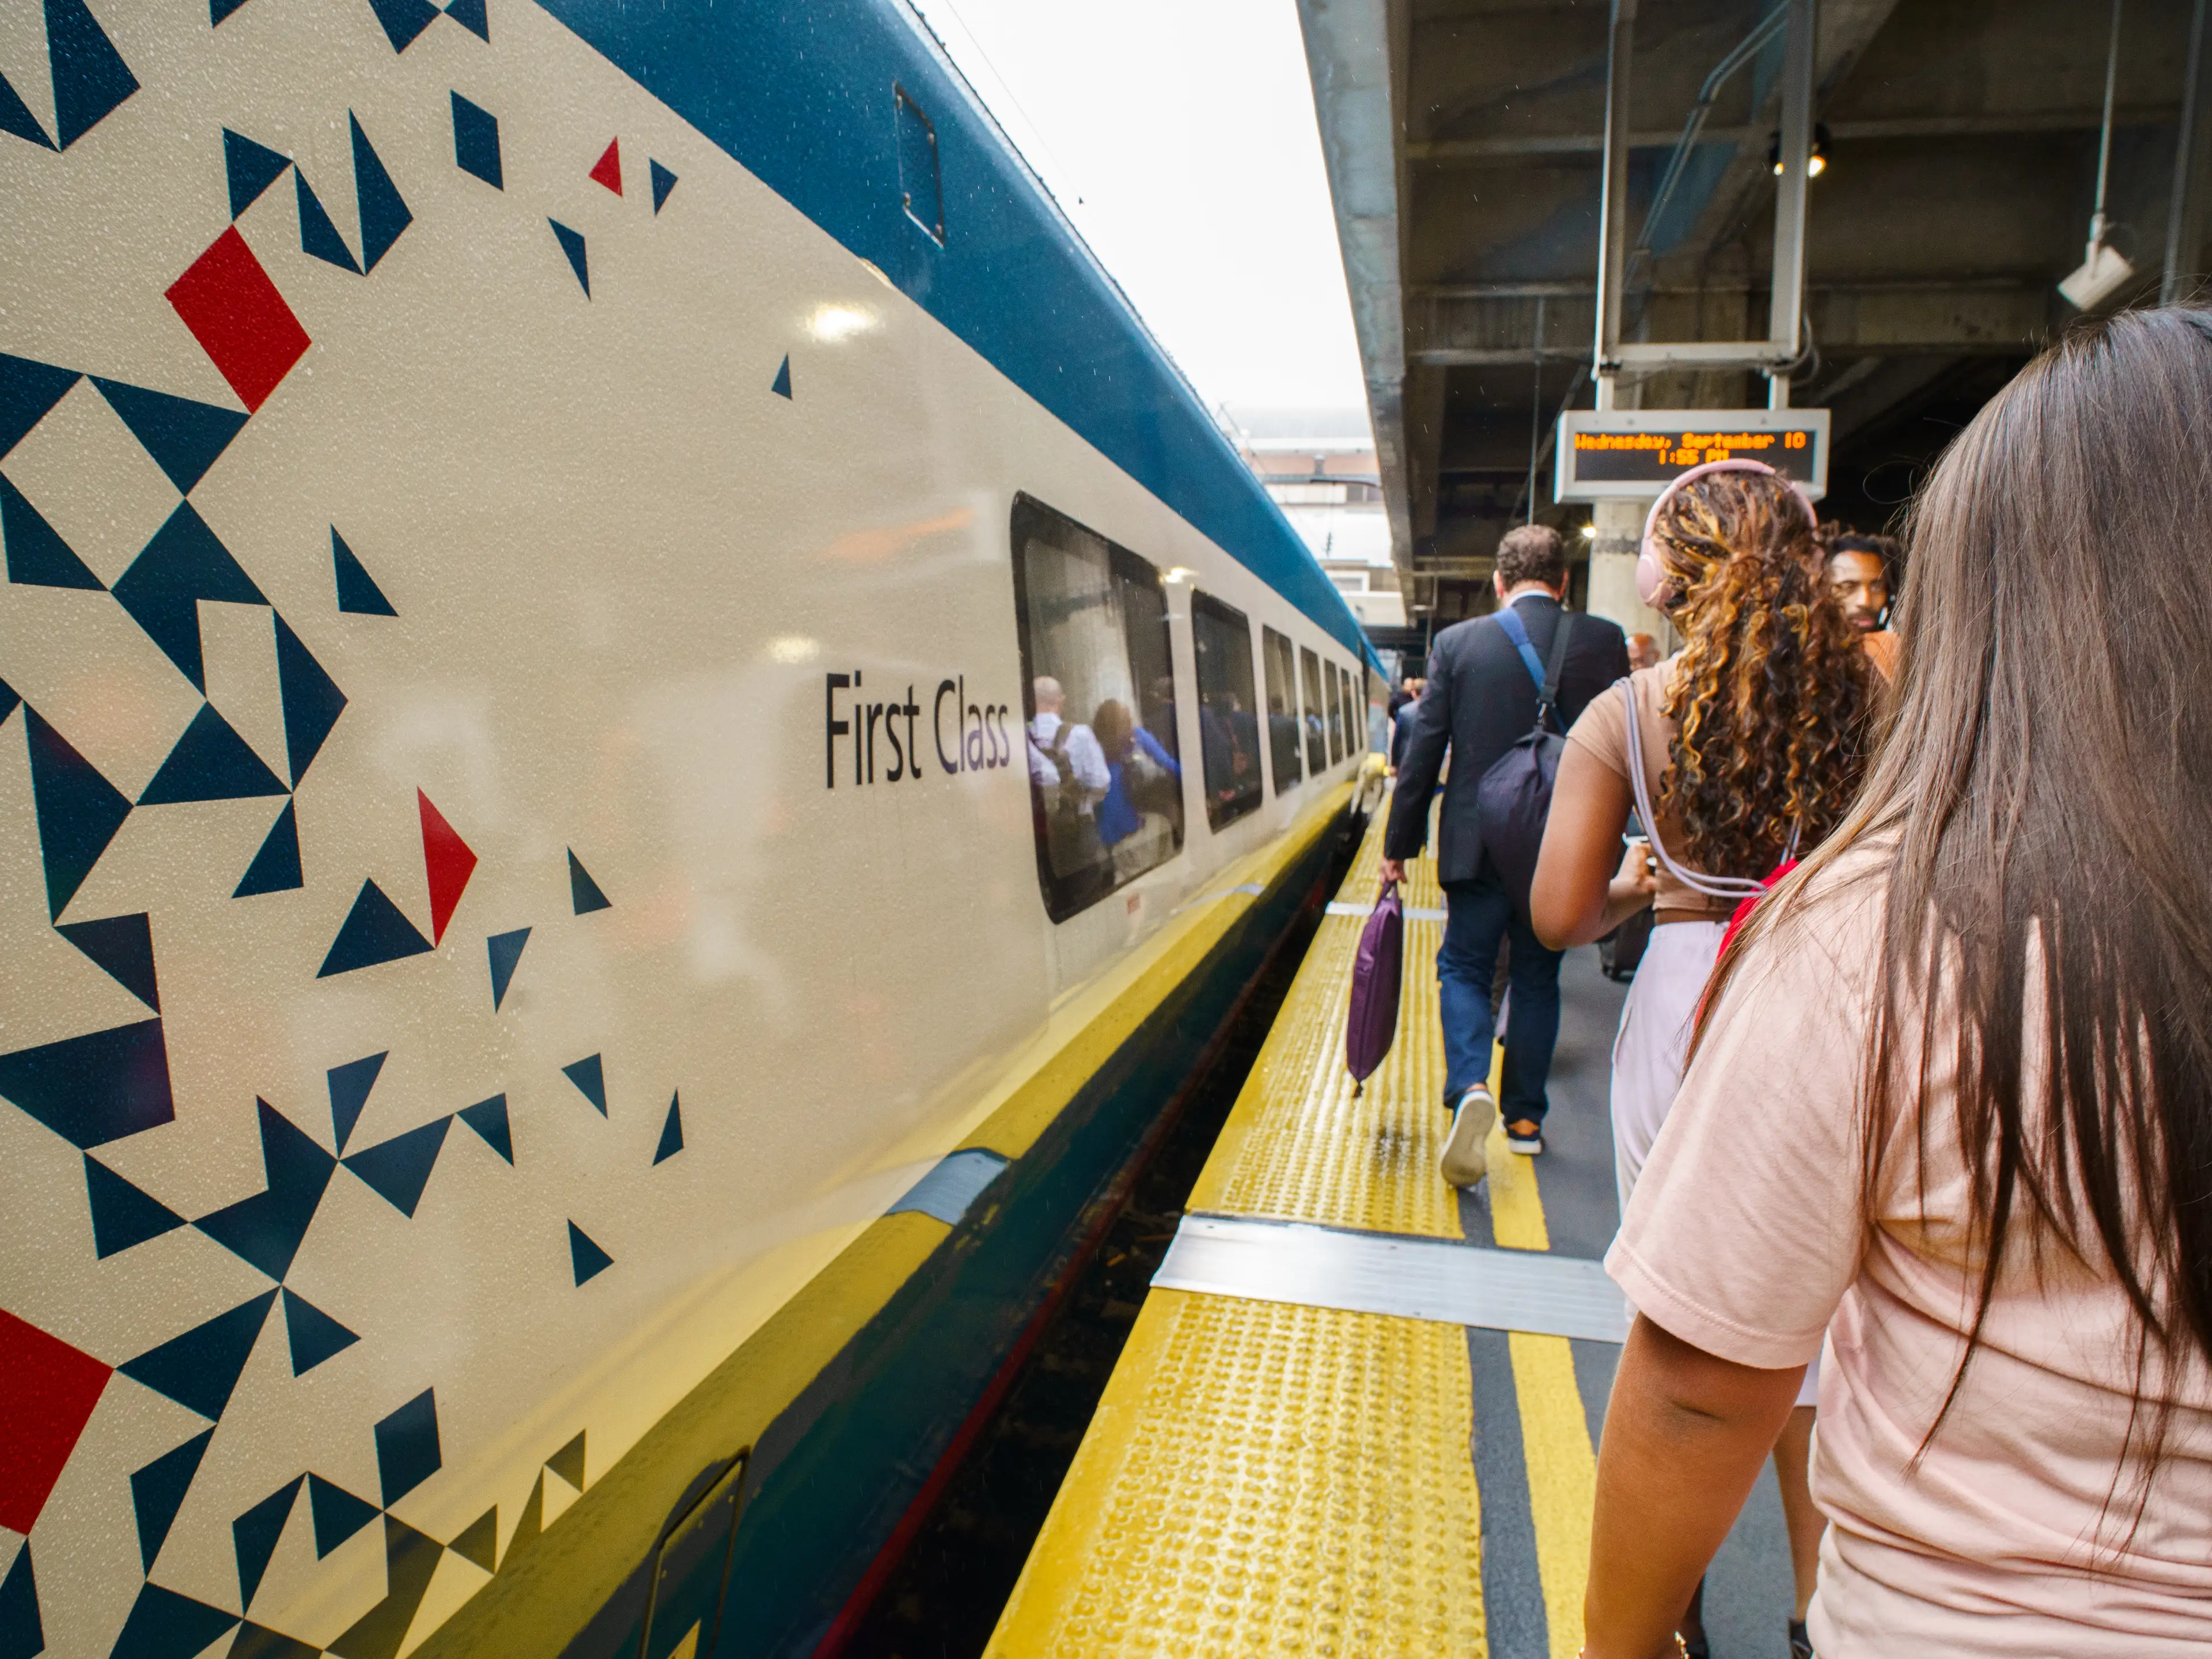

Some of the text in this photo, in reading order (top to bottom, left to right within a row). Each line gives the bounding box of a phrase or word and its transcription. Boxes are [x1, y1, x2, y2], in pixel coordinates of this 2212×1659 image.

[1574, 431, 1806, 449] Wednesday, September 10
[1659, 448, 1729, 465] 1:55 PM
[826, 669, 1010, 789] First Class
